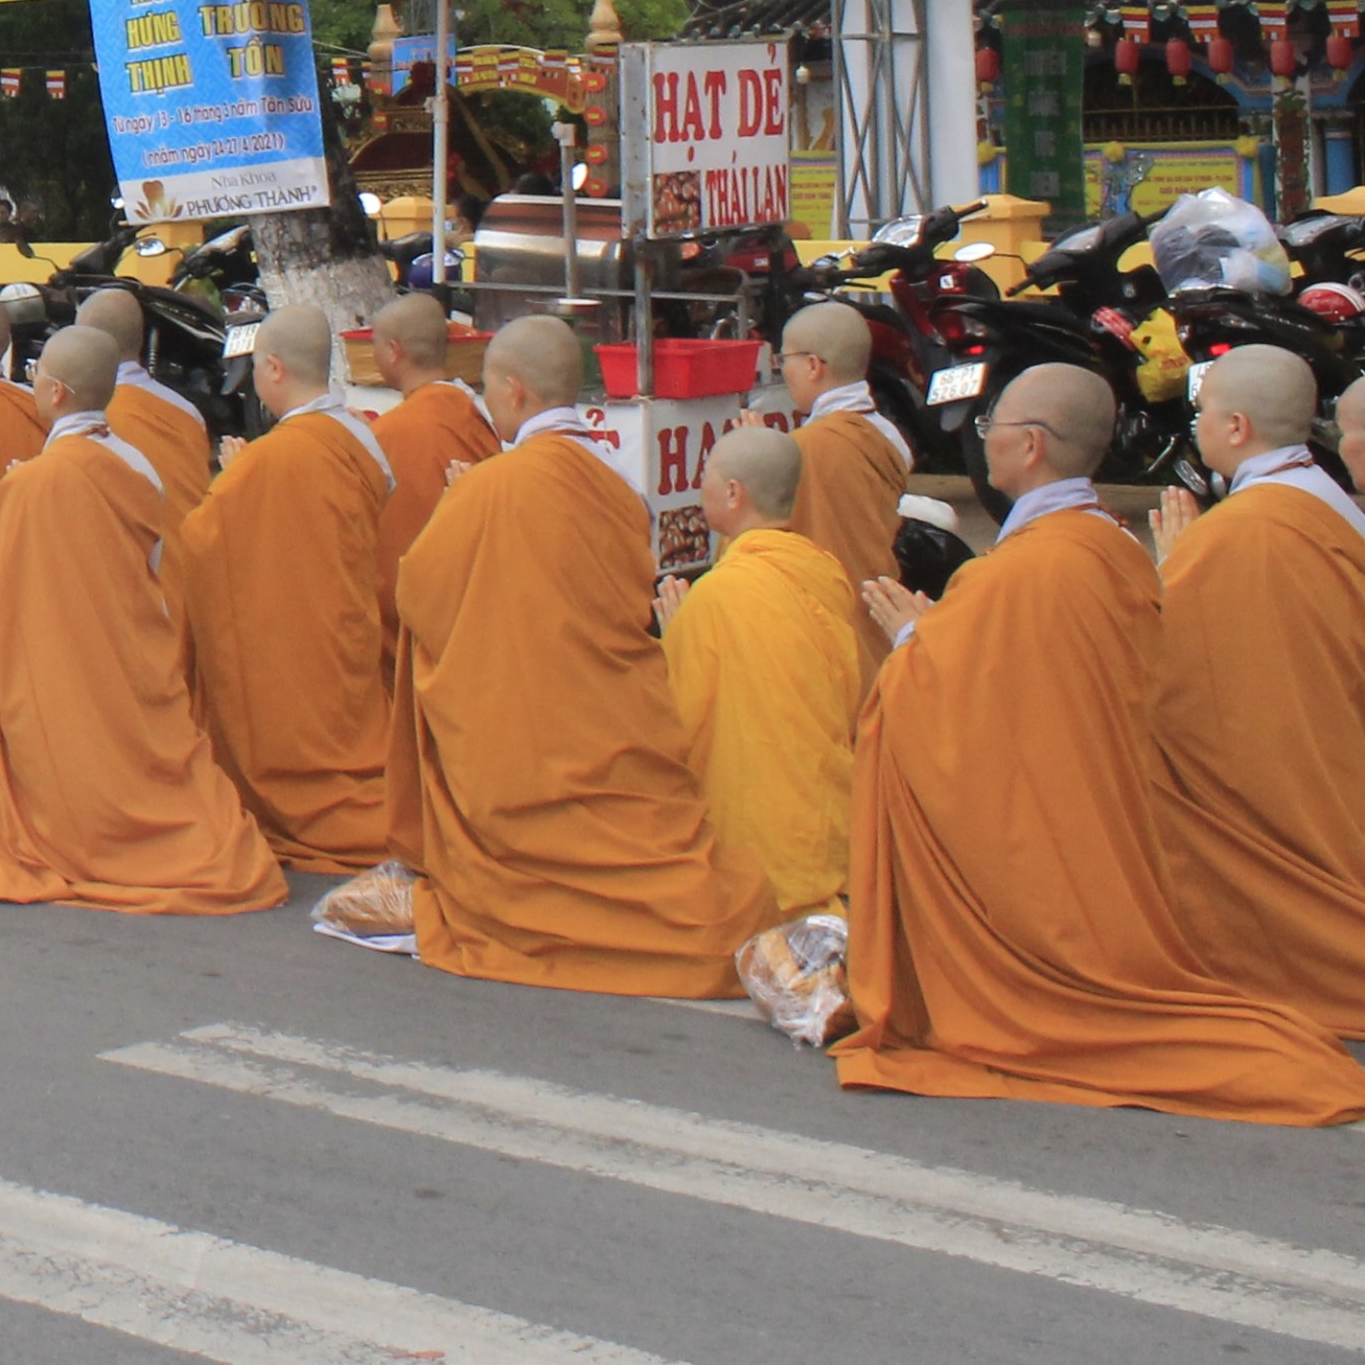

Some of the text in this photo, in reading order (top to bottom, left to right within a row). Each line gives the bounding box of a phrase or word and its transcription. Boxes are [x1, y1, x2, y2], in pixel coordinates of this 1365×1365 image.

[126, 53, 193, 95] THỊNH
[226, 38, 284, 78] TỒN
[652, 43, 785, 163] HẠT DẺ
[705, 150, 788, 227] THÁI LAN
